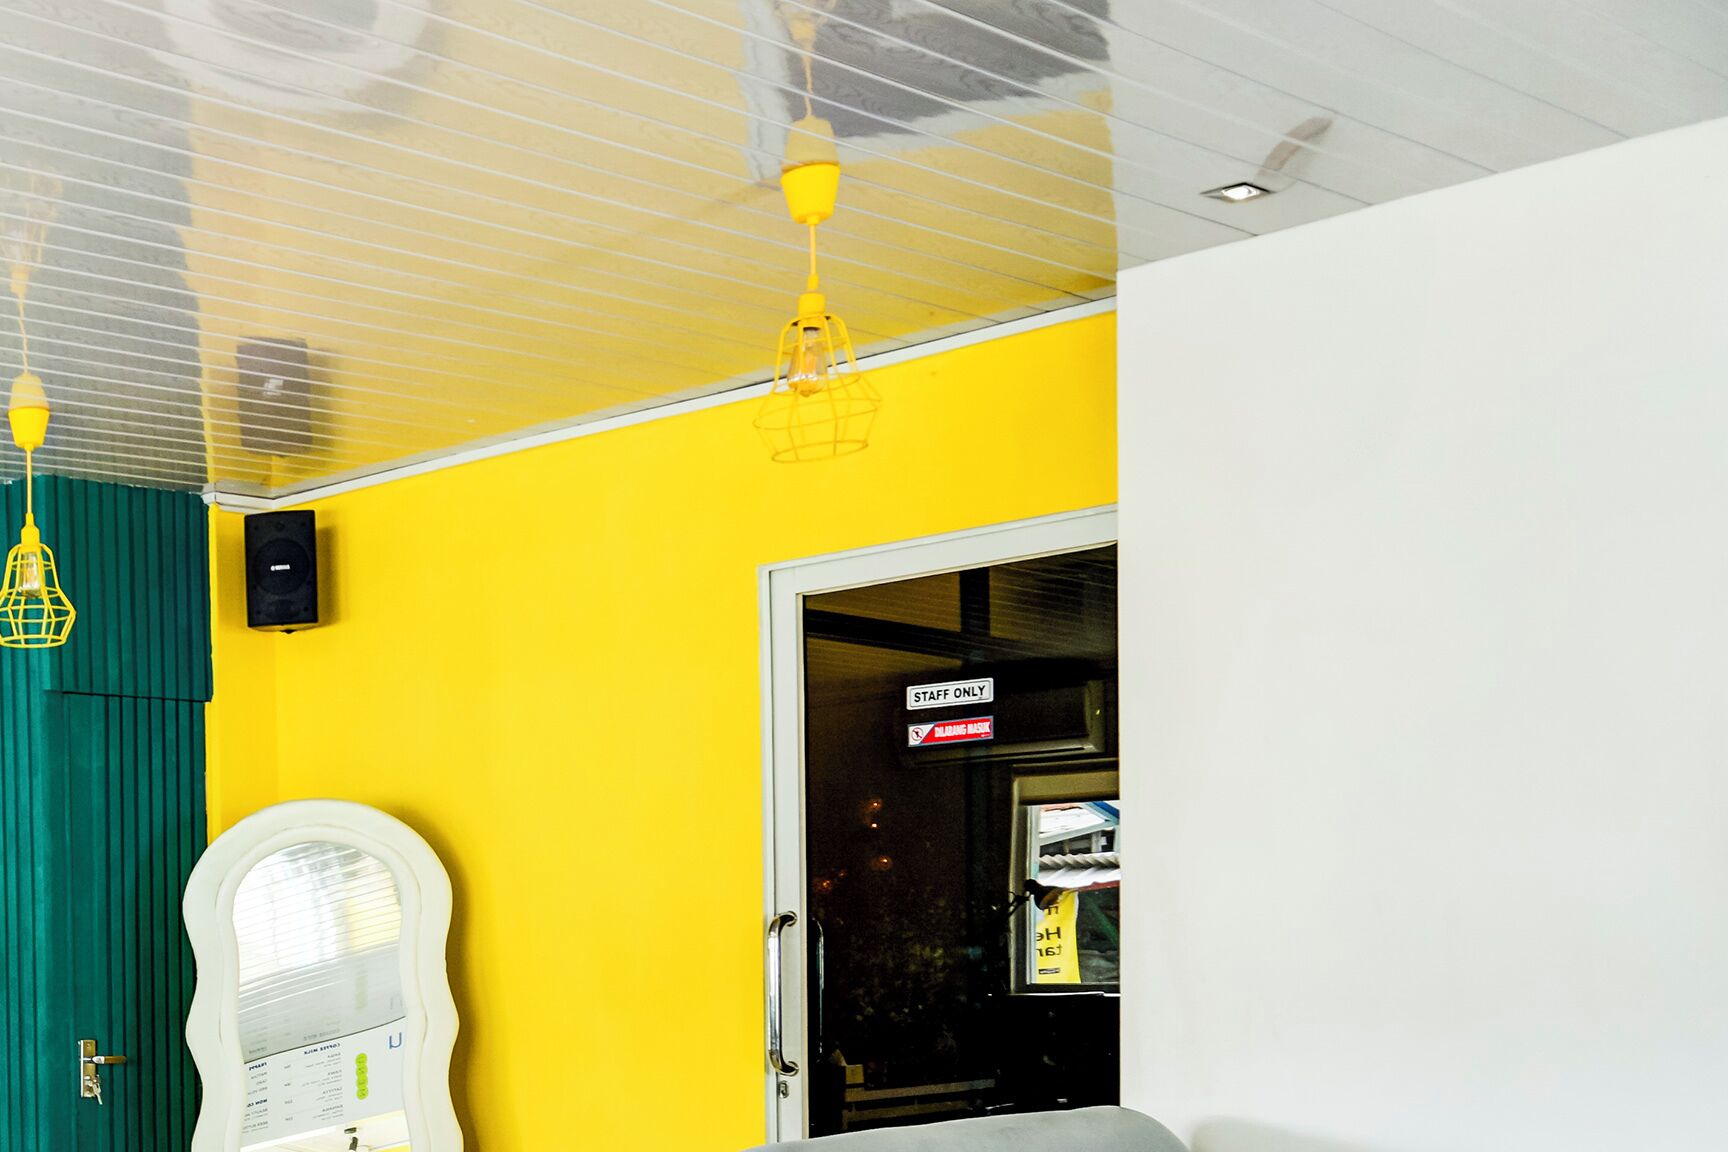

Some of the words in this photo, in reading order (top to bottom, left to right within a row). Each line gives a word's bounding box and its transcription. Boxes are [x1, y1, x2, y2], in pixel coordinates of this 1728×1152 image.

[914, 689, 950, 703] STAFF
[954, 685, 986, 698] ONLY
[934, 724, 967, 737] DILARANG
[967, 722, 991, 734] MASUK
